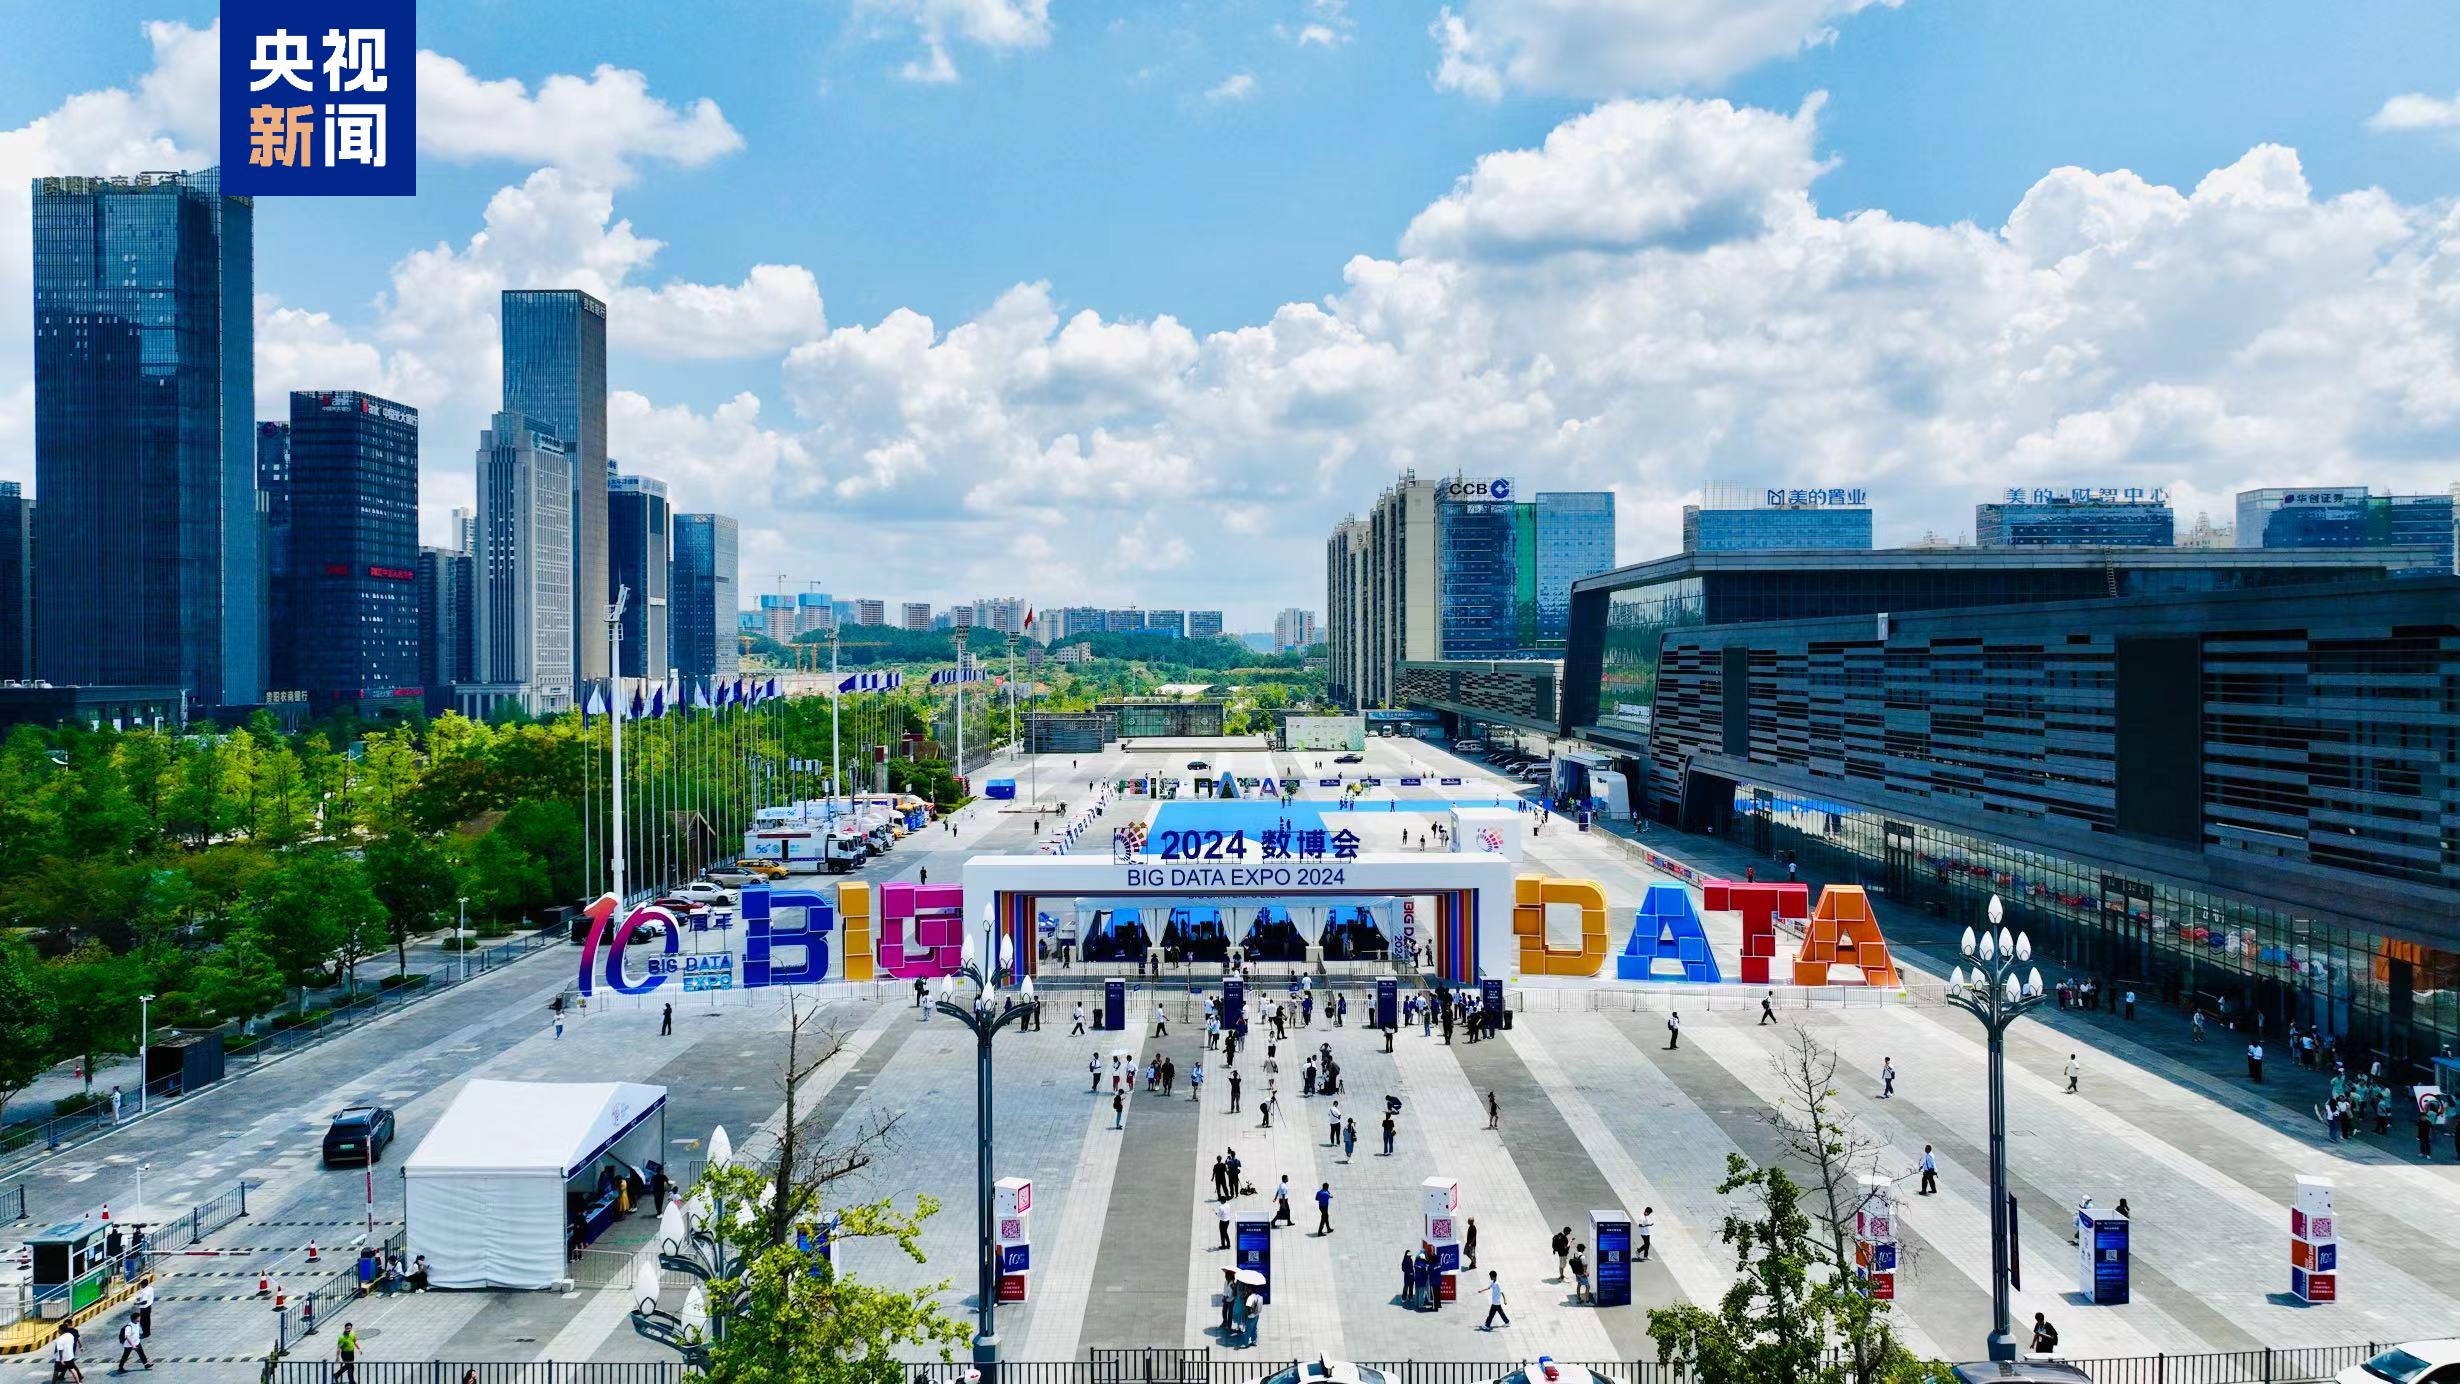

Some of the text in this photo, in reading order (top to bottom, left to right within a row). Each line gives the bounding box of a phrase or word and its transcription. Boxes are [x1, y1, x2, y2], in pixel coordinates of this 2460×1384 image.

[1449, 483, 1488, 495] CCB
[1788, 488, 1866, 505] 美的置业
[1161, 828, 1361, 860] 2024 数博会
[1127, 868, 1345, 886] BIG DATA EXPO 2024
[1403, 902, 1415, 924] BIG
[741, 873, 1904, 989] BIG DATA
[578, 892, 680, 998] 10
[648, 955, 732, 975] BIG DATA
[684, 975, 733, 993] EXPO
